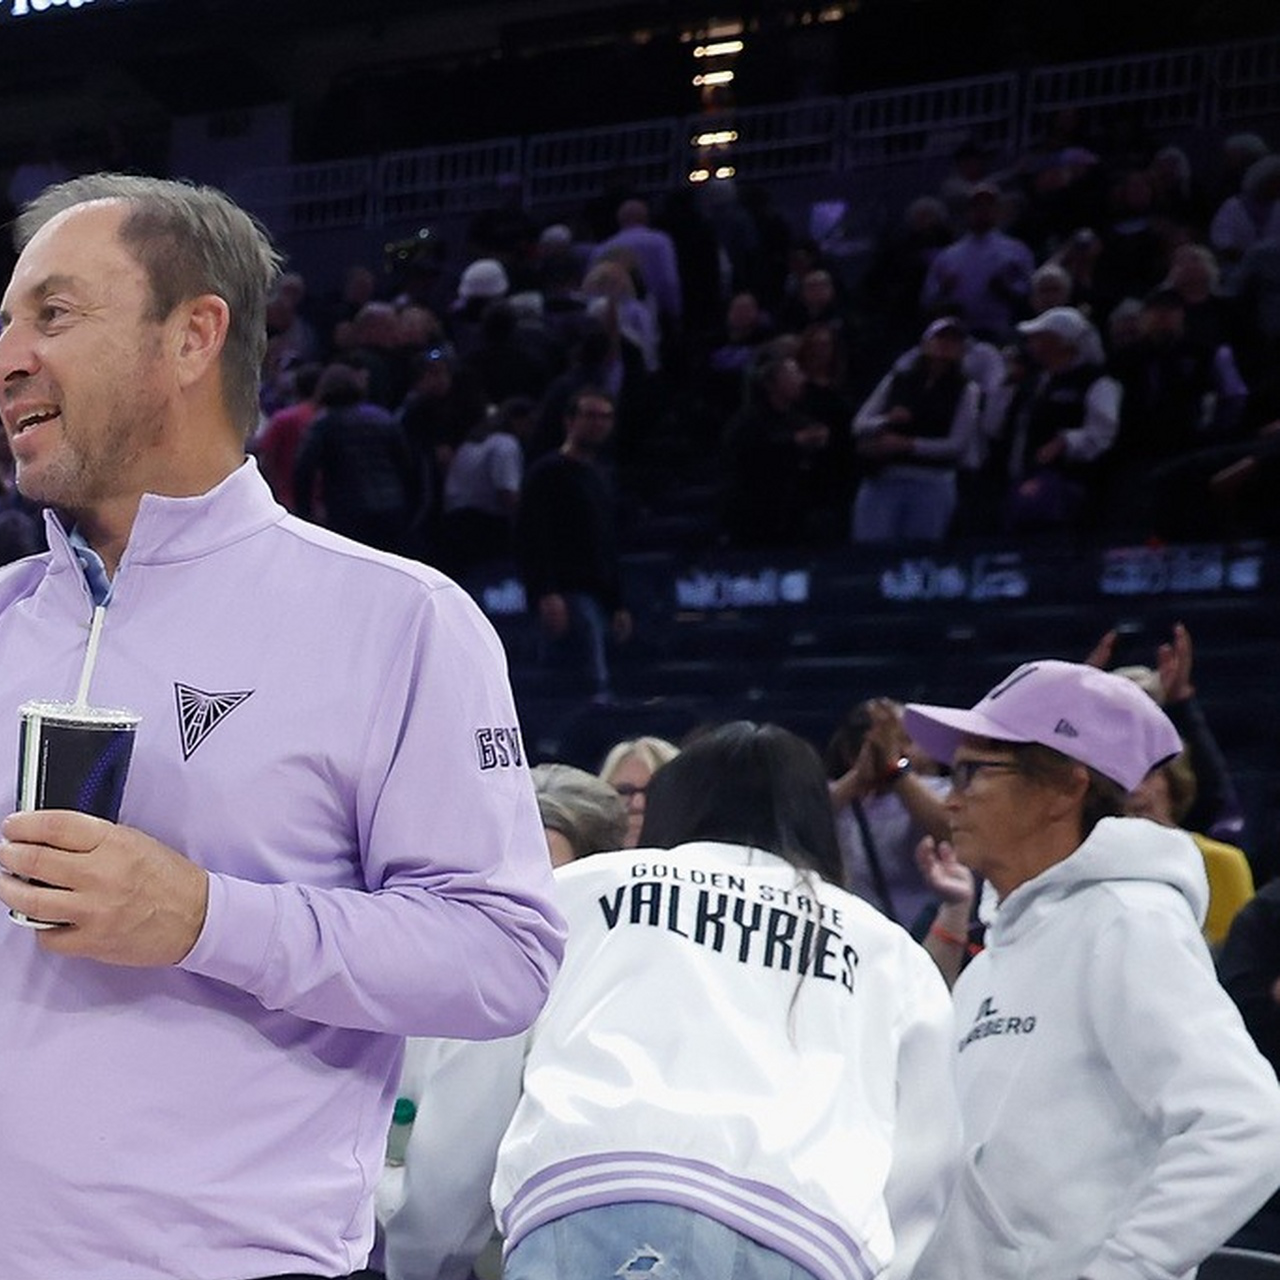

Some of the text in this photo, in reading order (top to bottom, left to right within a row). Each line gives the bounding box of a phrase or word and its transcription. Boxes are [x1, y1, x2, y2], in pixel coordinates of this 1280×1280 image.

[599, 882, 859, 995] VALKYRIES
[631, 863, 843, 929] GOLDEN STATE
